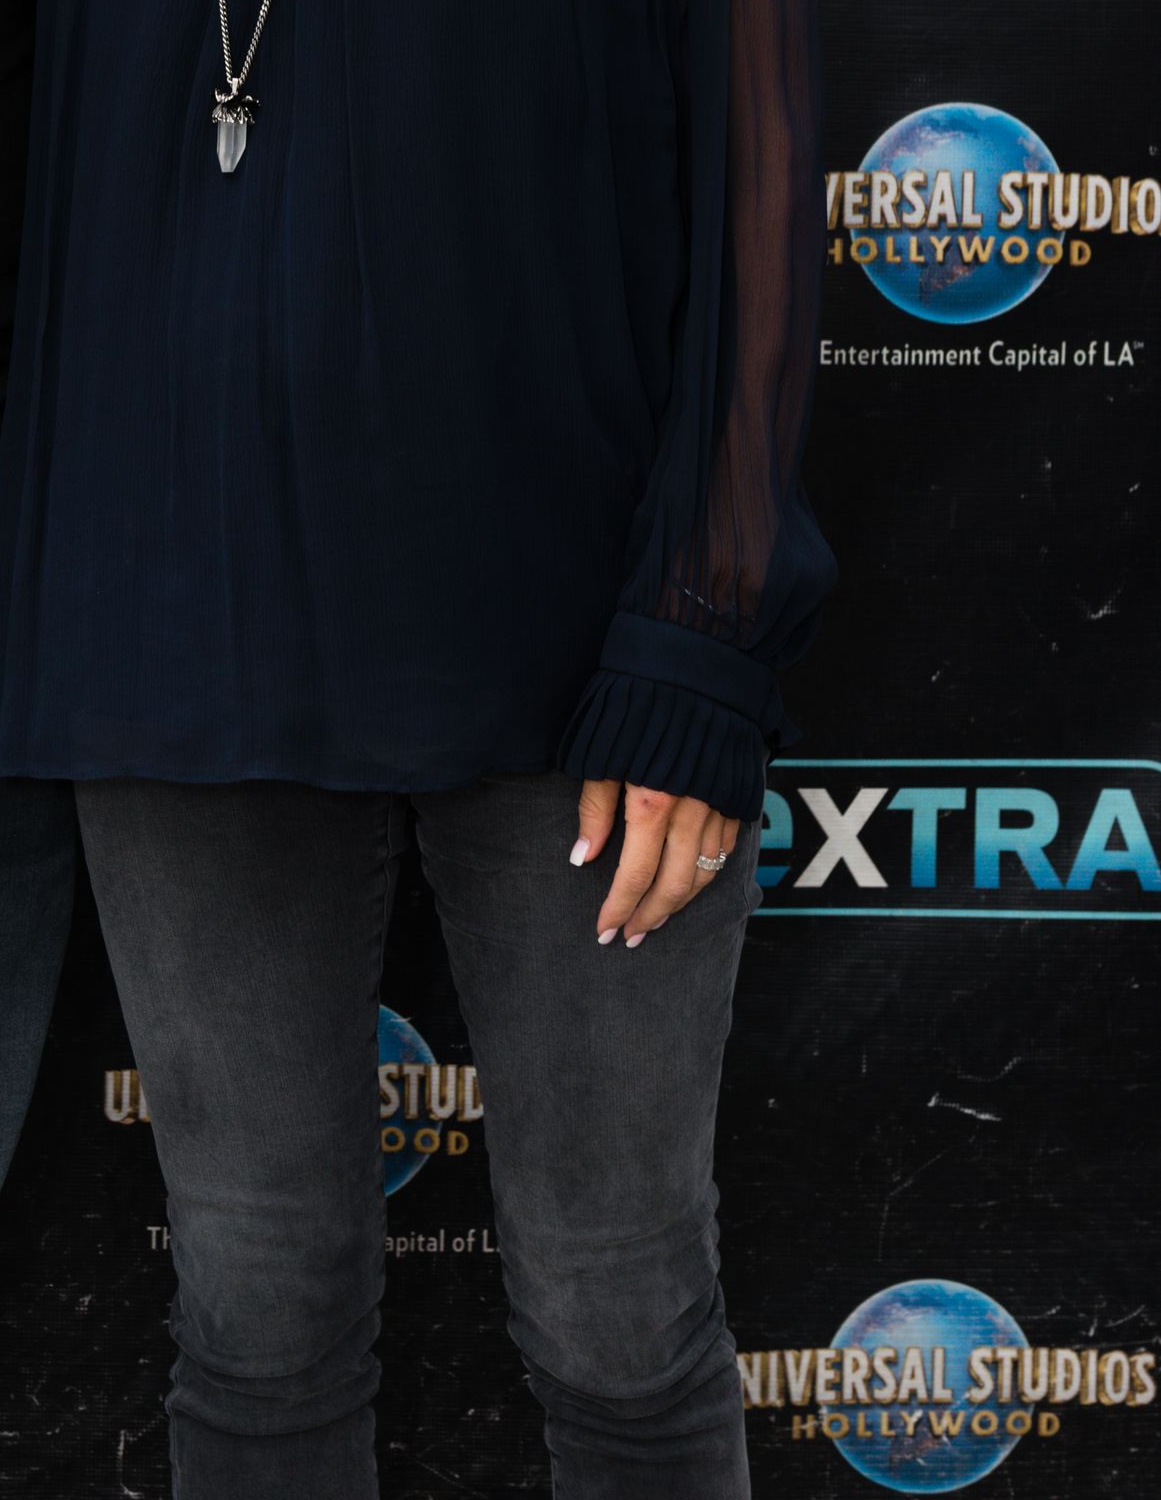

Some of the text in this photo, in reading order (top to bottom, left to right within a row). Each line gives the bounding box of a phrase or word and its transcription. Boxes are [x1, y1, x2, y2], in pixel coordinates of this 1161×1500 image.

[826, 170, 1161, 237] VERSAL STUDIO
[827, 235, 1092, 266] HOLLYWOOD
[819, 340, 981, 366] Entertainment
[988, 340, 1066, 371] Capital
[1073, 340, 1097, 366] of
[377, 1063, 484, 1122] STUD
[385, 1228, 445, 1258] apital
[452, 1228, 475, 1252] of
[737, 1347, 1158, 1410] NIVERSAL STUDIOS
[791, 1409, 1061, 1440] HOLLYWOOD
